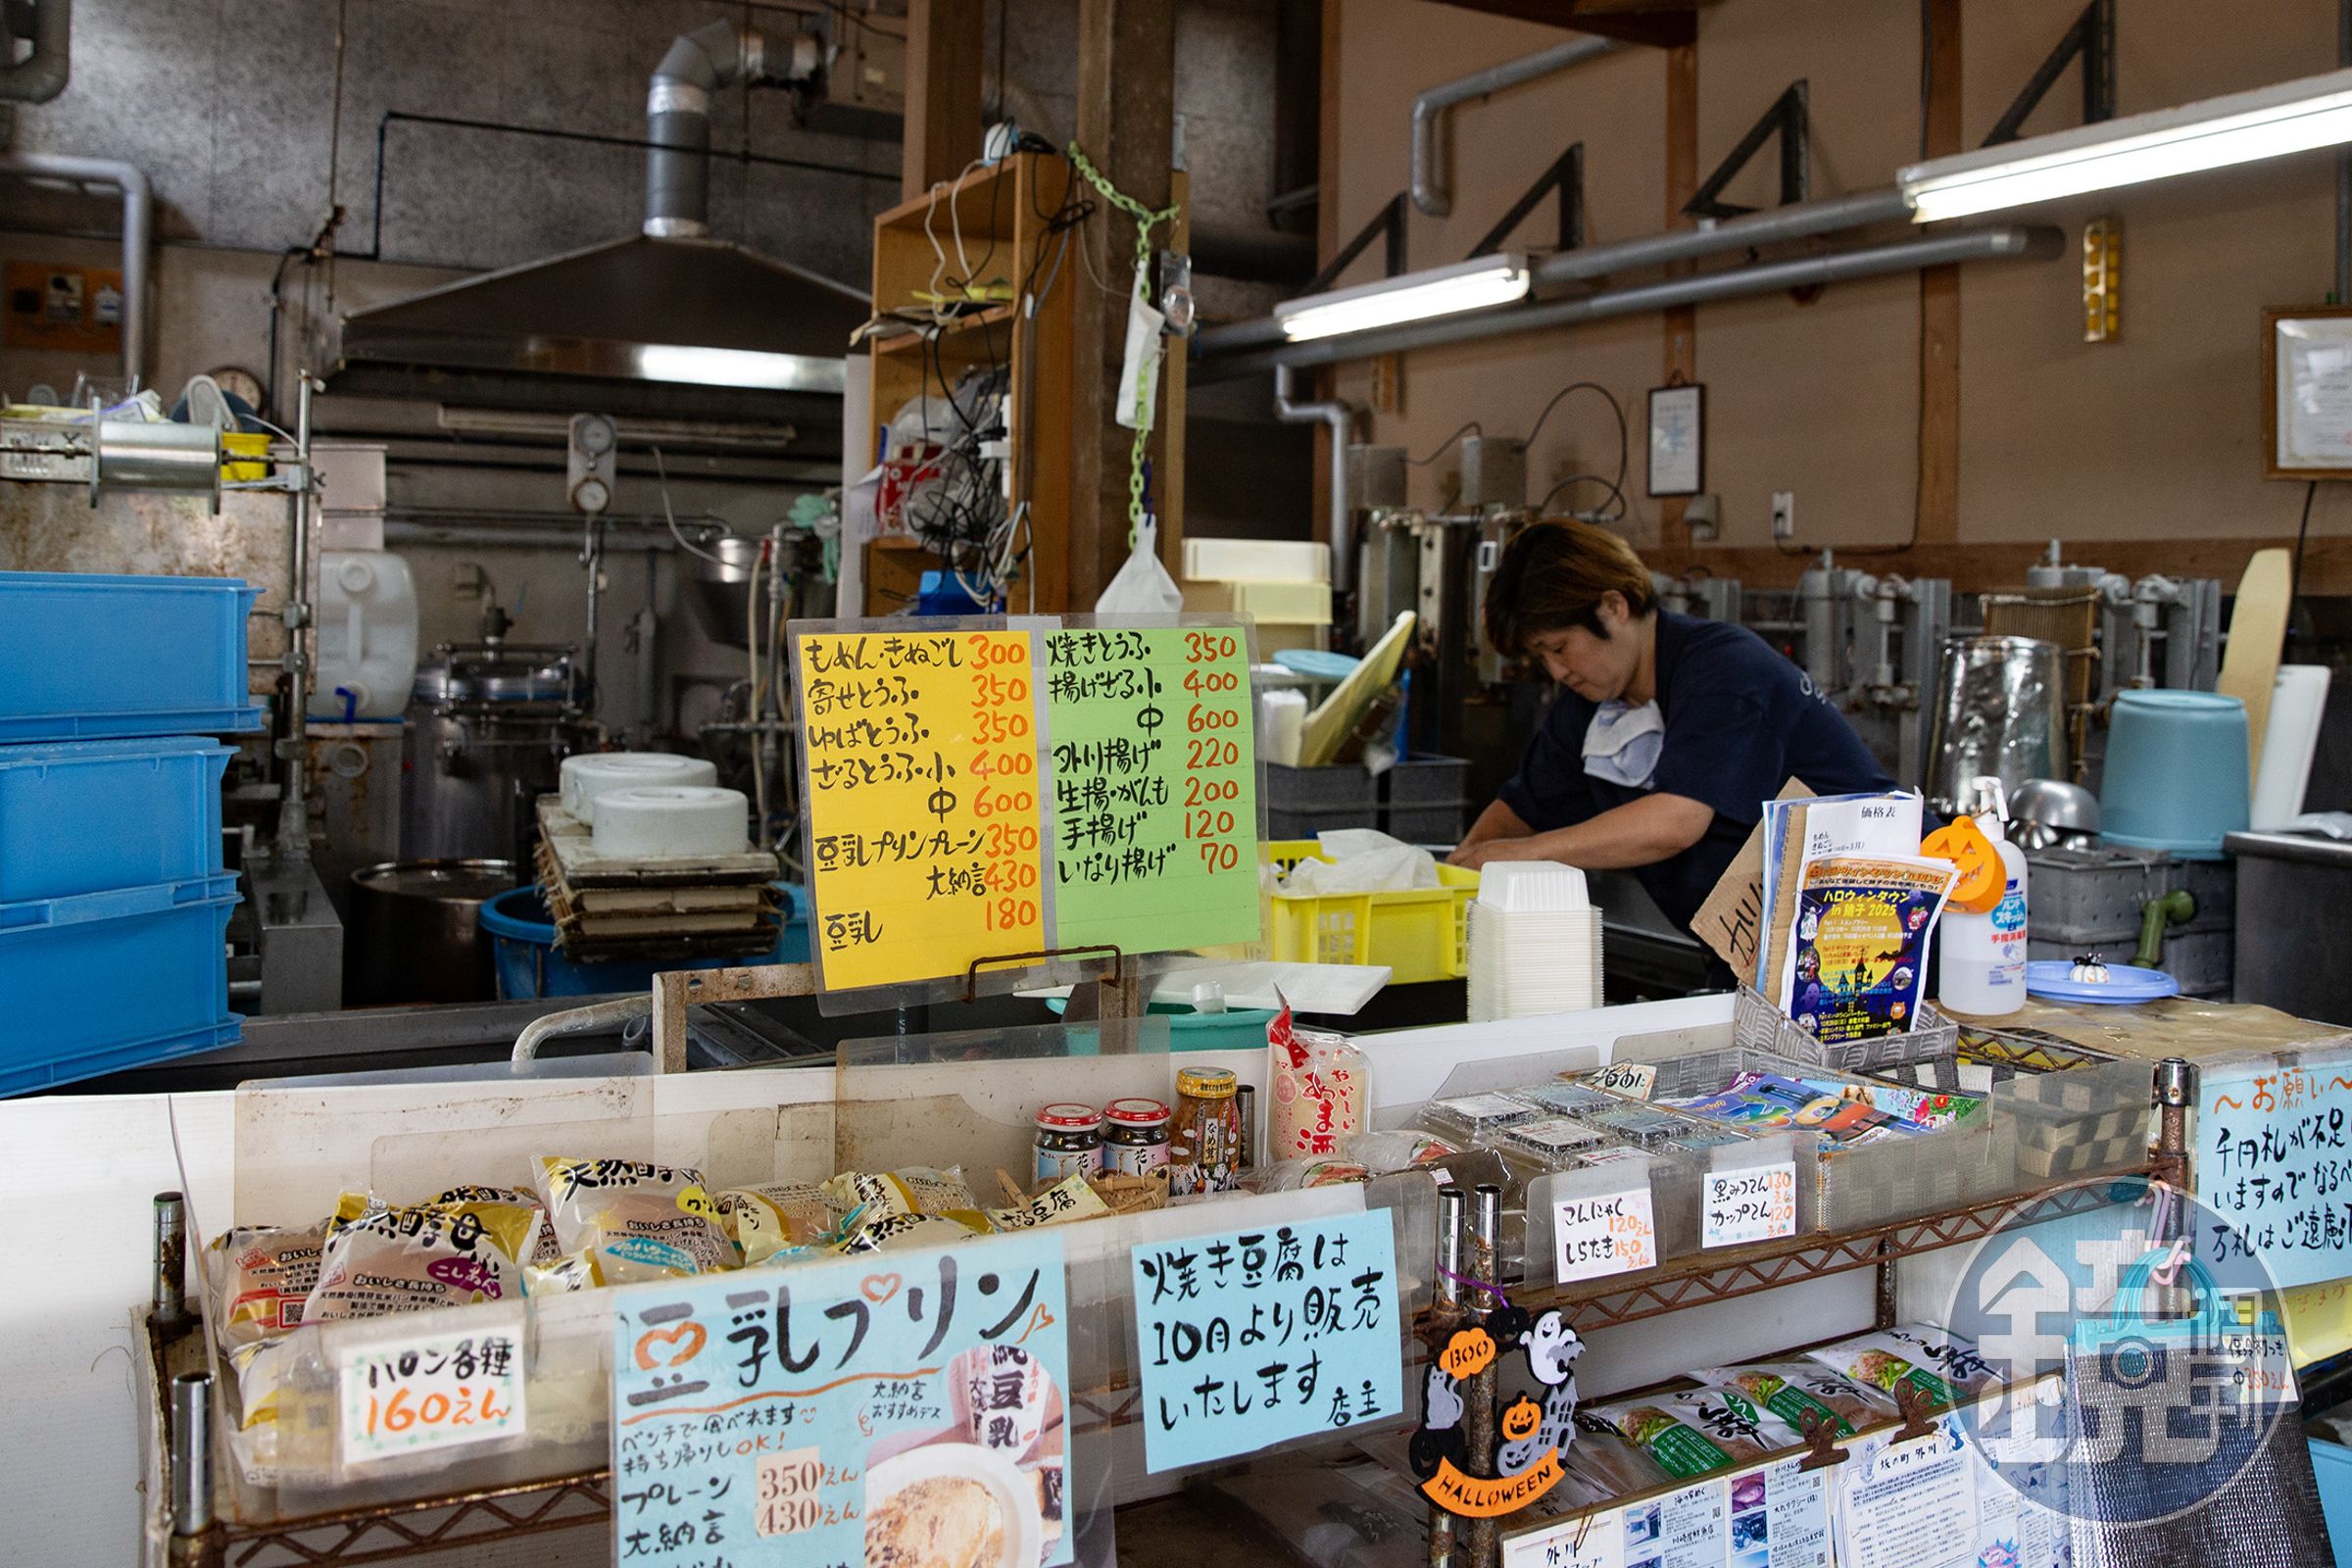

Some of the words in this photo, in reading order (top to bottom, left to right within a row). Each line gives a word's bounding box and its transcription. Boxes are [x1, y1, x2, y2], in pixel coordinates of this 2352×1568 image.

[969, 635, 1025, 669] 300
[1047, 631, 1152, 667] 焼きとうふ
[1184, 632, 1237, 664] 350
[808, 676, 919, 715] 寄せとうふ
[971, 674, 1027, 708] 350
[1184, 670, 1239, 698] 400
[808, 712, 930, 750] ゆばとうふ
[972, 710, 1028, 746] 350
[1137, 705, 1164, 738] 中
[1187, 707, 1239, 734] 600
[969, 750, 1032, 781] 400
[1186, 738, 1240, 771] 220
[928, 786, 957, 823] 中
[973, 786, 1033, 818] 600
[1183, 778, 1239, 808] 200
[1861, 806, 1896, 818] 価格表
[985, 823, 1038, 858] 350
[1061, 812, 1150, 850] 手揚げ
[1185, 810, 1235, 840] 120
[984, 860, 1037, 893] 430
[1058, 844, 1176, 885] いなり揚げ
[1200, 842, 1239, 874] 70
[1824, 889, 1911, 904] ハロウィンタウン
[1868, 905, 1897, 917] 2025
[825, 910, 884, 951] 豆乳
[986, 899, 1037, 931] 180
[1296, 1071, 1337, 1155] あま酒
[1331, 1069, 1356, 1130] おいしい
[2215, 1106, 2352, 1177] 千円札が不足
[1001, 1189, 1076, 1227] ざる豆腐
[1563, 1198, 1623, 1226] こんにゃく
[1140, 1226, 1349, 1305] 焼き豆腐は
[1566, 1235, 1613, 1264] しらたき
[1615, 1239, 1642, 1256] 150
[353, 1273, 447, 1295] おいしさ長持ち
[435, 1264, 499, 1299] こしあん
[1152, 1266, 1384, 1365] 10月より販売
[1448, 1340, 1490, 1370] BOO
[871, 1379, 927, 1400] 大納言
[1160, 1349, 1323, 1431] いたします
[1327, 1380, 1382, 1428] 店主
[366, 1385, 512, 1438] 160えん
[621, 1474, 733, 1515] プレーン
[1439, 1465, 1551, 1507] HALLOWEEN
[622, 1509, 726, 1559] 大納言
